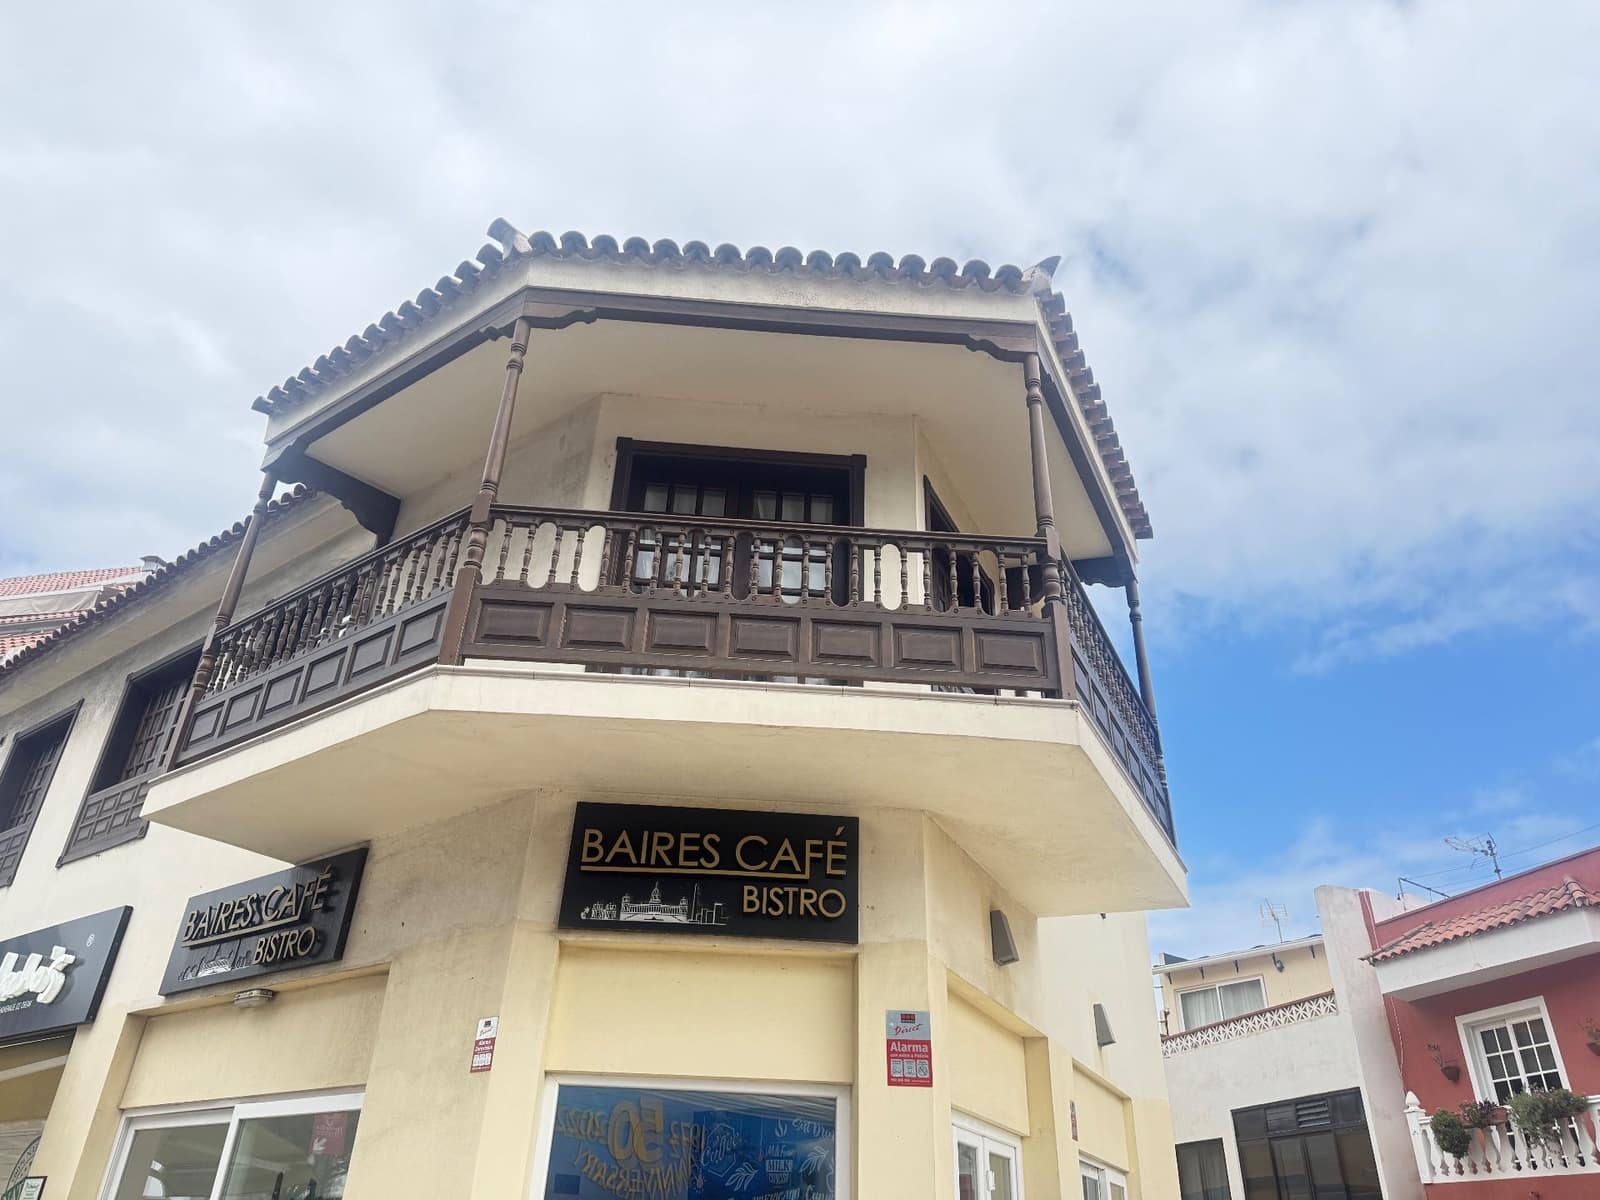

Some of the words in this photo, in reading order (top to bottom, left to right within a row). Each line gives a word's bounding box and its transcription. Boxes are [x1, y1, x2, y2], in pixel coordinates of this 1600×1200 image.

[581, 829, 721, 869] BAIRES
[736, 826, 848, 878] CAFÉ
[183, 895, 258, 942] BAIRES
[261, 865, 333, 921] CAFÉ
[743, 885, 847, 918] BISTRO
[253, 926, 316, 966] BISTRO
[890, 1041, 928, 1052] Alarma
